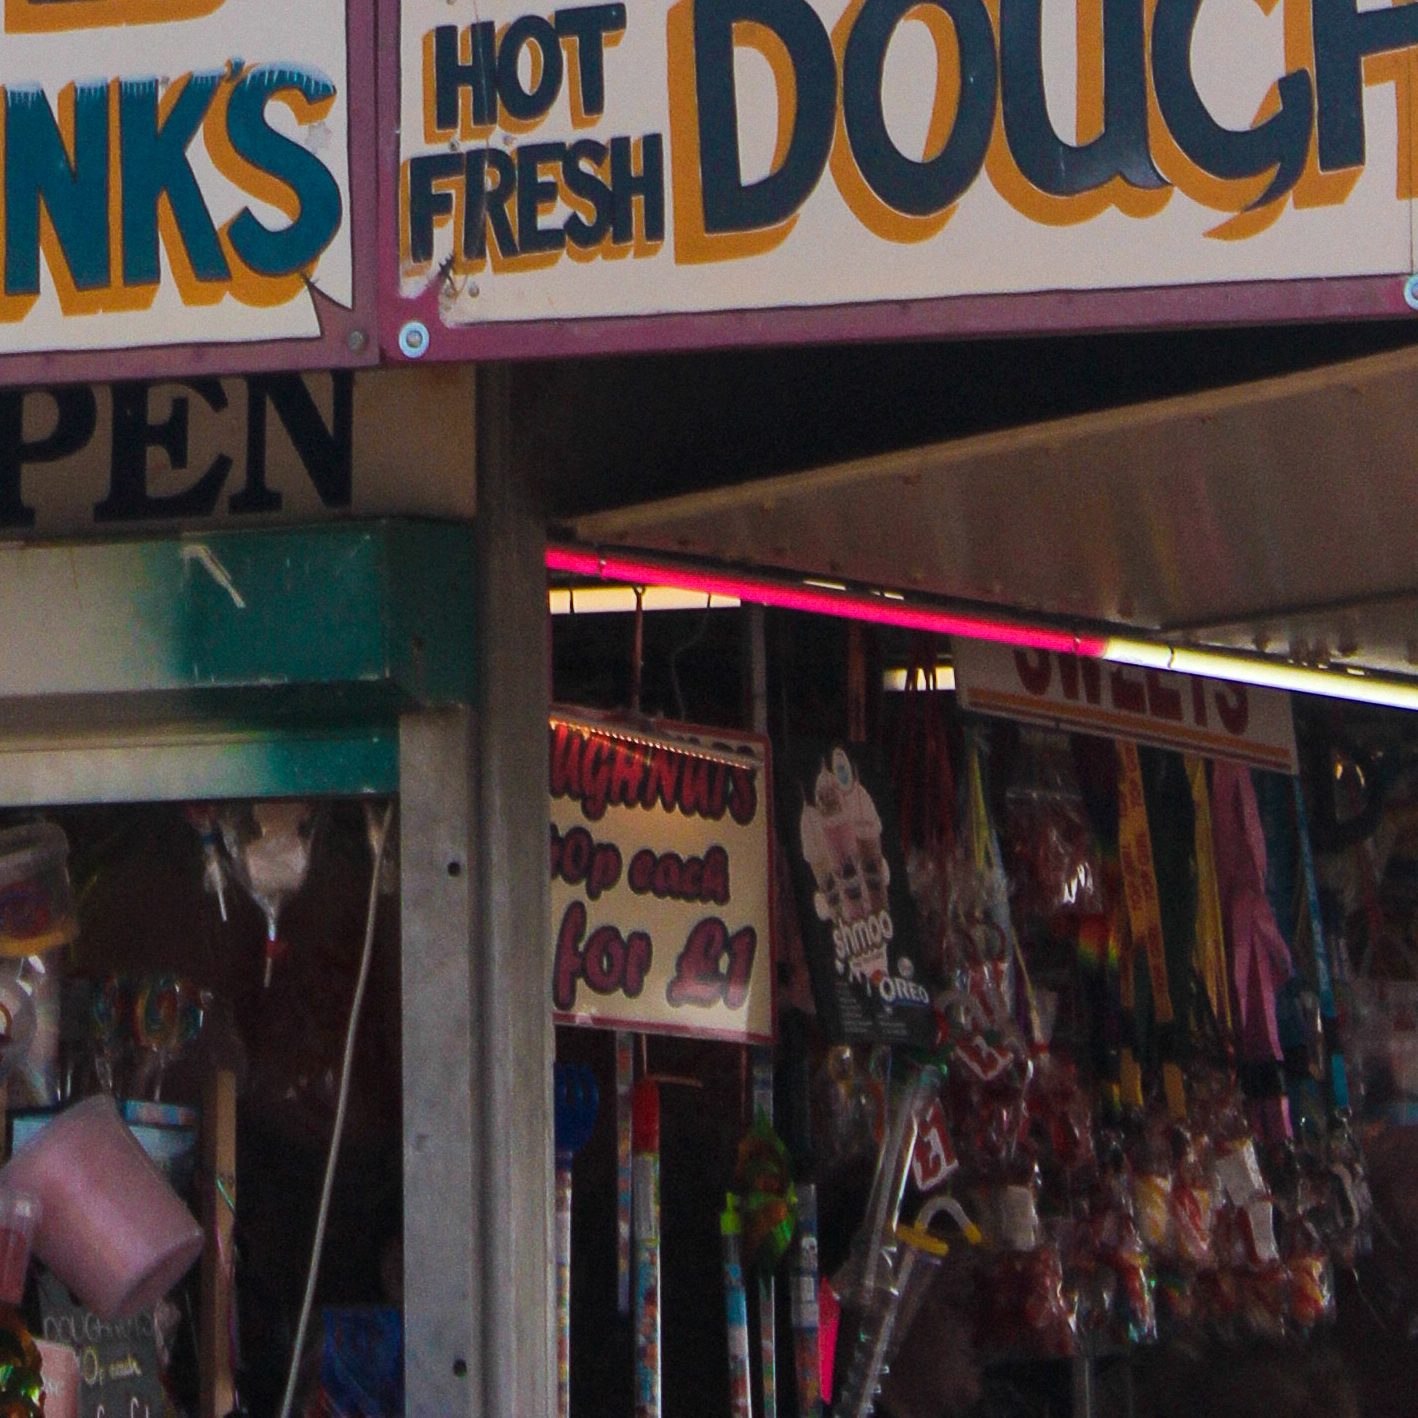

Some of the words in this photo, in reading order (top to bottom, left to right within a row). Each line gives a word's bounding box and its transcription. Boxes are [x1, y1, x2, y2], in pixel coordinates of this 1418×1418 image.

[423, 3, 626, 141] HOT
[400, 134, 665, 277] FRESH
[552, 901, 653, 1011] for
[666, 916, 758, 1009] £1
[832, 909, 894, 959] shmoo
[879, 976, 930, 1005] OREO
